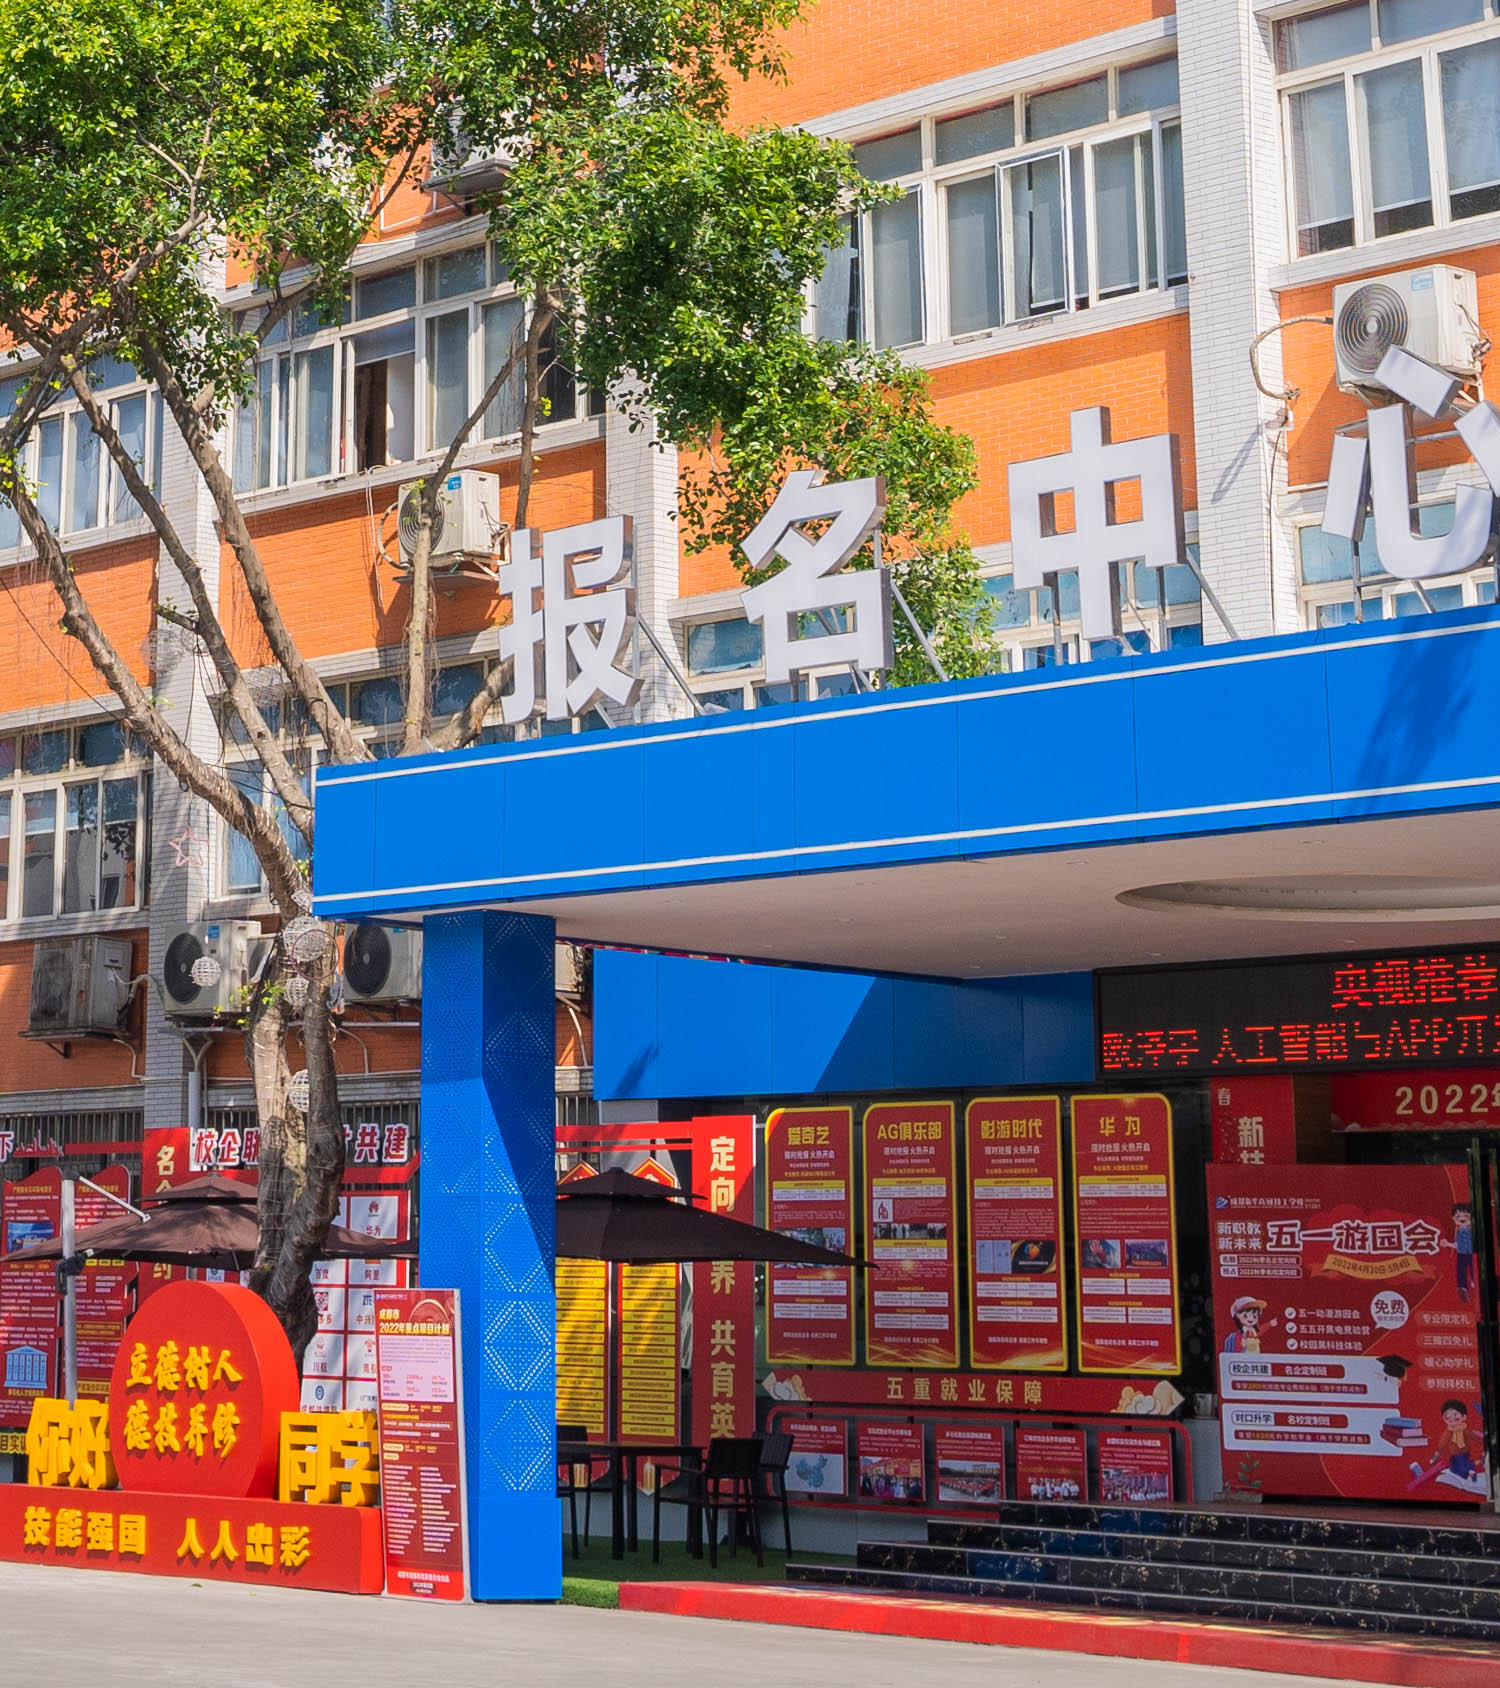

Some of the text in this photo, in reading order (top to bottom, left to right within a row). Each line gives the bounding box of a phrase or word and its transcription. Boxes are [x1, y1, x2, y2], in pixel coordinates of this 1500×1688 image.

[787, 1125, 830, 1146] 爱奇艺
[876, 1121, 942, 1141] AG俱乐部
[980, 1117, 1043, 1140] 影游时代
[1099, 1115, 1141, 1137] 华为
[709, 1135, 736, 1295] 定向养
[1266, 1219, 1440, 1256] 五一游园会
[1374, 1299, 1406, 1315] 免费
[126, 1340, 243, 1391] 立德树人
[1232, 1363, 1269, 1375] 校企共建
[886, 1376, 1044, 1406] 五重就业保障
[1234, 1412, 1273, 1424] 对口升学
[27, 1398, 118, 1491] 你好
[279, 1410, 379, 1508] 同学
[24, 1506, 314, 1568] 技能强国 人人出彩
